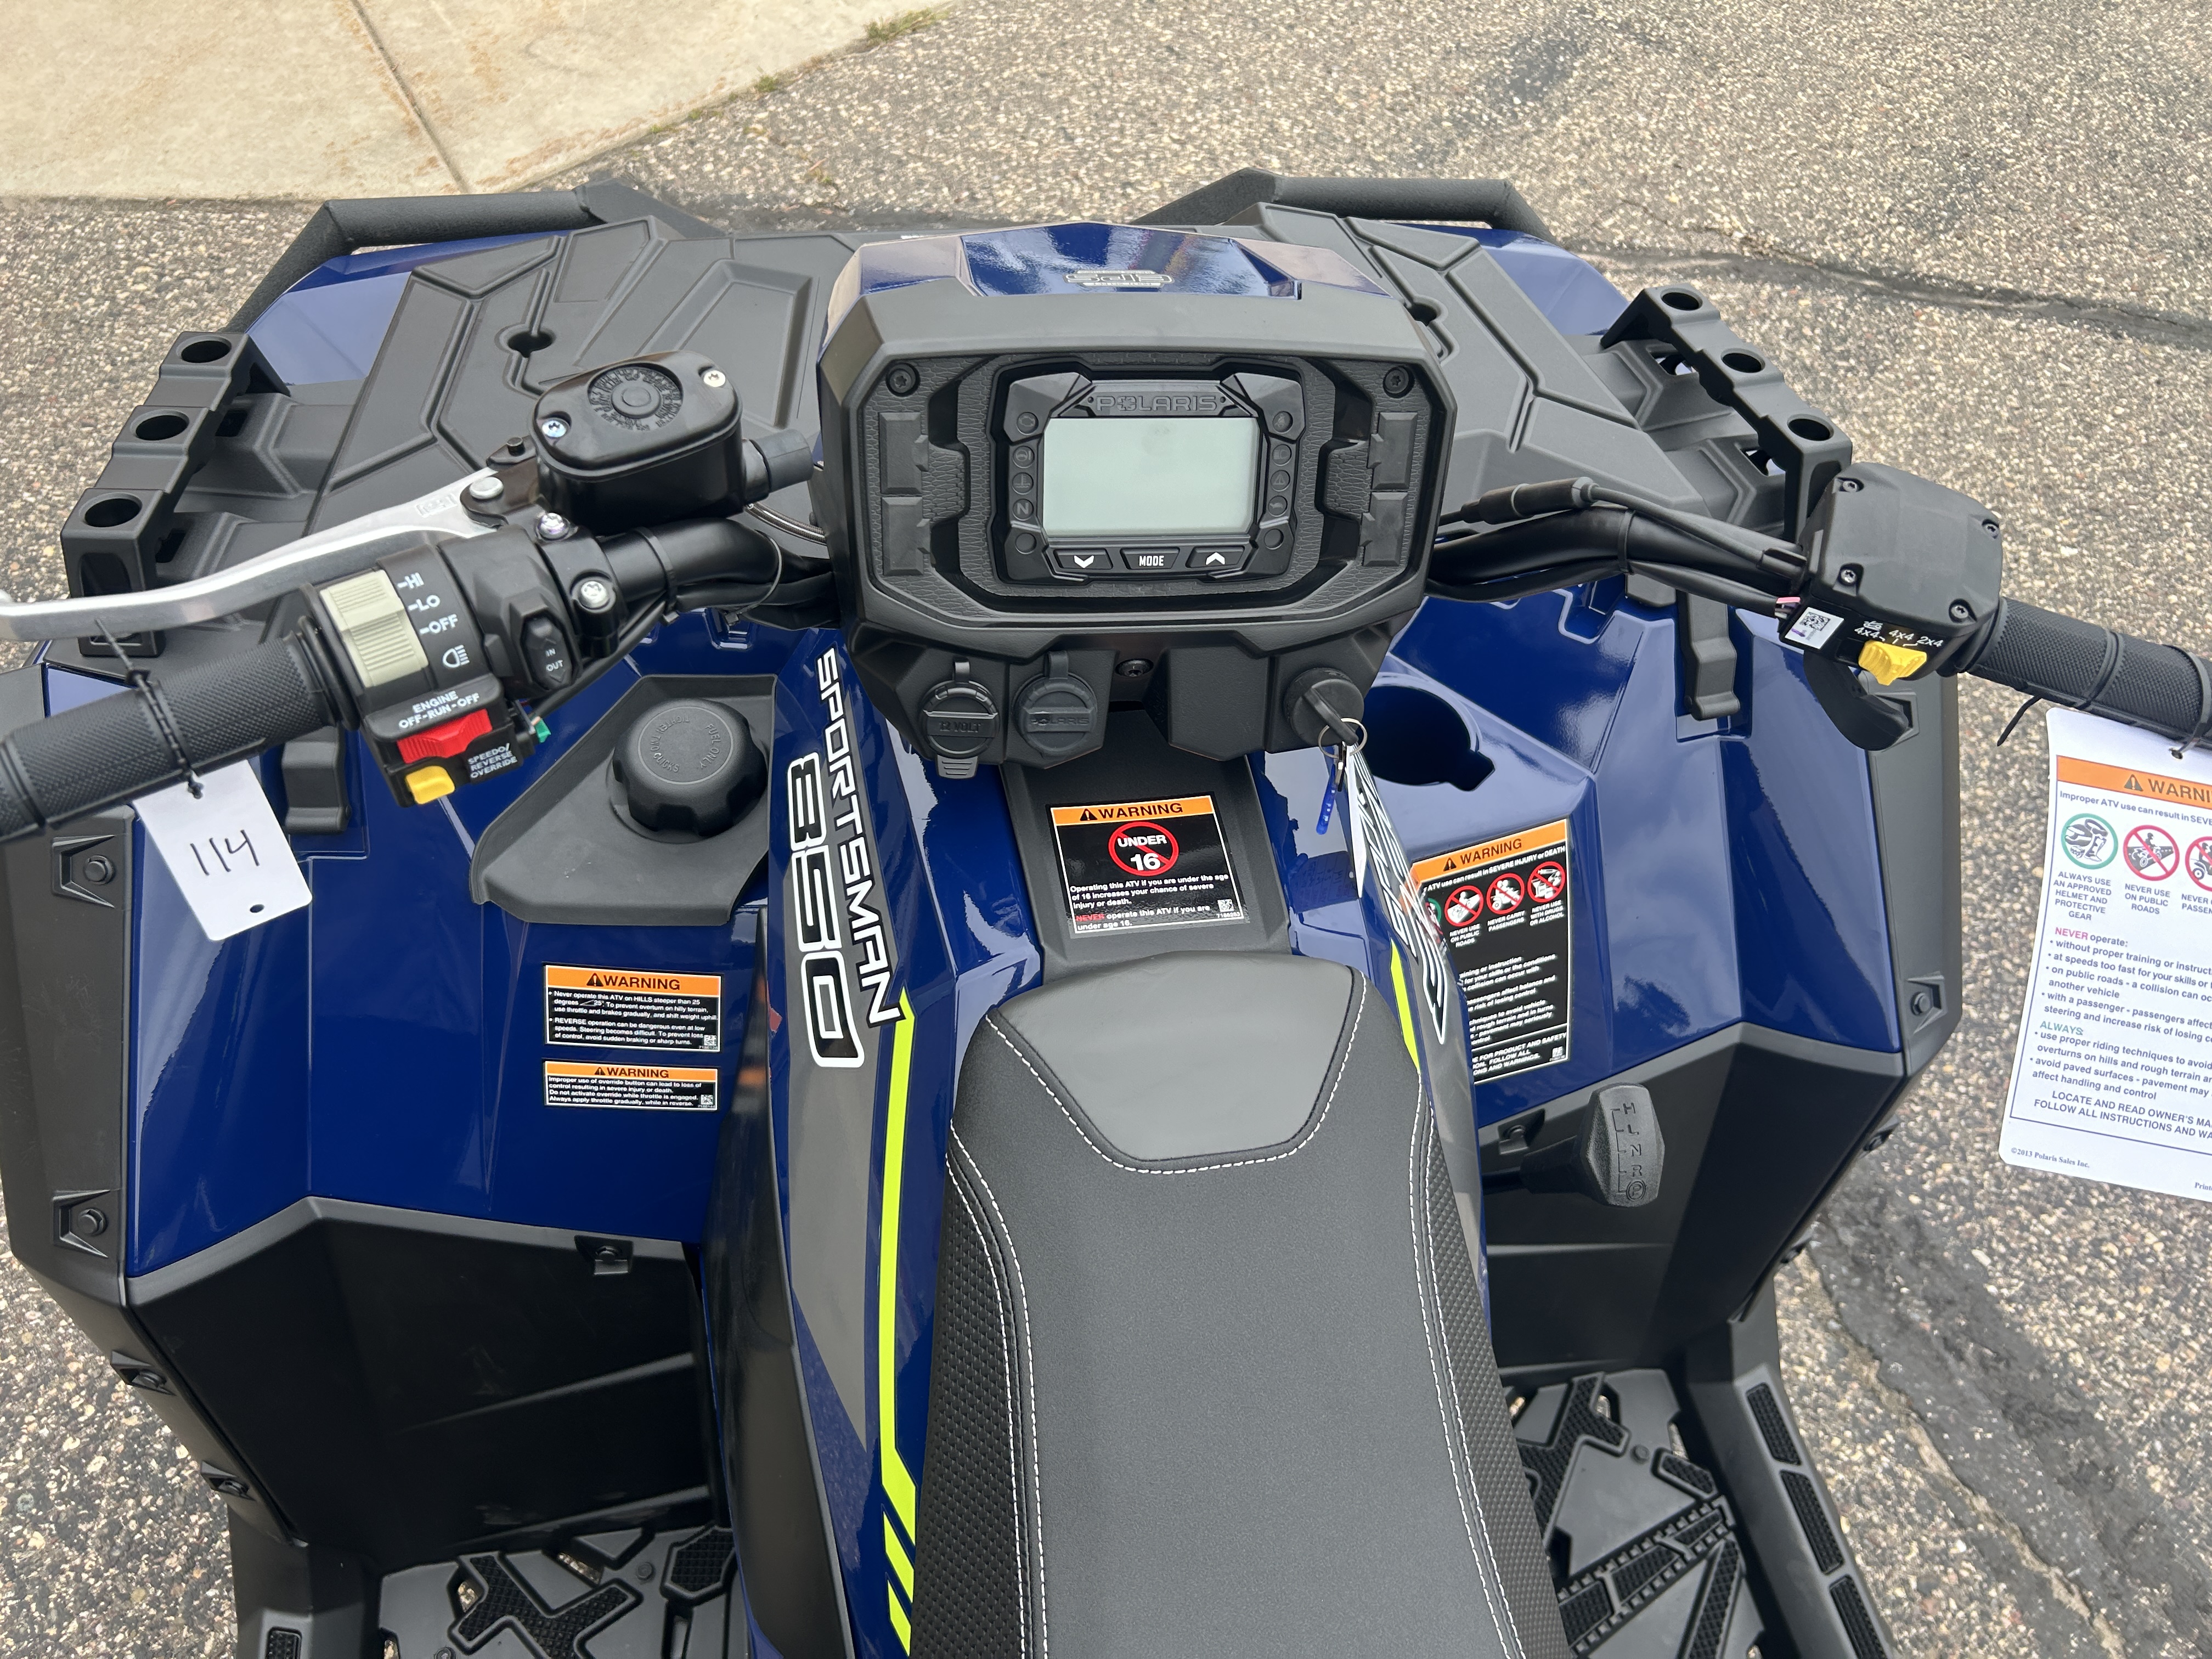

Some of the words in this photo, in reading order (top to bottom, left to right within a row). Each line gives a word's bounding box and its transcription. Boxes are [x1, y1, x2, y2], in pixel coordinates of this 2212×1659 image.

[1097, 396, 1217, 411] POLARIS
[1017, 502, 1029, 515] N
[1139, 555, 1164, 567] MODE
[405, 572, 424, 589] HI
[417, 595, 441, 609] LO
[431, 614, 459, 634] OFF
[545, 648, 556, 657] IN
[546, 659, 564, 672] OUT
[412, 690, 459, 714] ENGINE
[705, 723, 721, 744] FUEL
[953, 721, 981, 733] VOLT
[468, 743, 511, 765] SPEEDO/
[470, 751, 514, 771] REVERSE
[699, 747, 720, 769] ONLY
[470, 755, 518, 779] OVERRIDE
[653, 752, 680, 773] CLICKS
[2148, 778, 2212, 803] WARNI
[1098, 803, 1183, 819] WARNING
[2060, 791, 2099, 804] Improper
[2101, 799, 2119, 808] ATV
[2138, 806, 2153, 815] can
[2155, 810, 2180, 820] result
[817, 645, 902, 1025] SPORTSMAN
[1118, 835, 1167, 847] UNDER
[190, 829, 260, 876] 114
[1460, 839, 1522, 865] WARNING
[1131, 853, 1162, 872] 16
[1427, 882, 1441, 891] ATV
[1488, 860, 1514, 874] SEVERE
[1514, 854, 1537, 866] INJURY
[1544, 845, 1567, 857] DEATH
[2058, 871, 2092, 883] ALWAYS
[2095, 878, 2111, 887] USE
[1070, 884, 1108, 893] Operating
[2056, 889, 2089, 900] HELMET
[2090, 896, 2107, 904] AND
[2067, 882, 2112, 895] APPROVED
[2125, 883, 2152, 894] NEVER
[2154, 889, 2170, 898] USE
[2055, 899, 2106, 914] PROTECTIVE
[2125, 893, 2137, 901] ON
[2139, 895, 2168, 906] PUBLIC
[2181, 894, 2208, 904] NEVER
[788, 752, 865, 1068] 850
[1076, 913, 1105, 922] NEVER
[1106, 910, 1138, 920] operate
[1156, 907, 1171, 916] ATV
[2069, 911, 2092, 921] GEAR
[2131, 903, 2160, 915] ROADS
[1077, 923, 1102, 932] under
[1120, 919, 1133, 928] 16.
[2055, 927, 2088, 940] NEVER
[2090, 935, 2128, 947] operate:
[2056, 940, 2090, 952] without
[2092, 947, 2124, 958] proper
[2126, 952, 2161, 967] training
[2176, 961, 2212, 975] instruct
[2065, 956, 2098, 967] speeds
[2101, 961, 2115, 970] too
[2118, 964, 2135, 974] fast
[2138, 968, 2151, 977] for
[2153, 972, 2172, 981] your
[2174, 975, 2196, 985] skills
[602, 975, 680, 990] WARNING
[607, 1067, 669, 1078] WARNING
[2033, 1070, 2058, 1081] affect
[2061, 1075, 2101, 1091] handling
[2103, 1085, 2121, 1093] and
[2124, 1088, 2157, 1099] control
[1623, 1102, 1635, 1114] H
[2052, 1091, 2092, 1105] LOCATE
[2094, 1099, 2115, 1109] AND
[2118, 1103, 2145, 1115] READ
[2148, 1109, 2194, 1124] OWNER'S
[2034, 1099, 2076, 1113] FOLLOW
[2078, 1108, 2097, 1118] ALL
[2100, 1111, 2172, 1132] INSTRUCTIONS
[2174, 1126, 2196, 1136] AND
[1628, 1125, 1639, 1135] L
[1630, 1144, 1641, 1156] N
[2034, 1152, 2057, 1162] Polaris
[2058, 1156, 2075, 1165] Sales
[2077, 1160, 2090, 1168] Inc.
[1631, 1165, 1642, 1177] R
